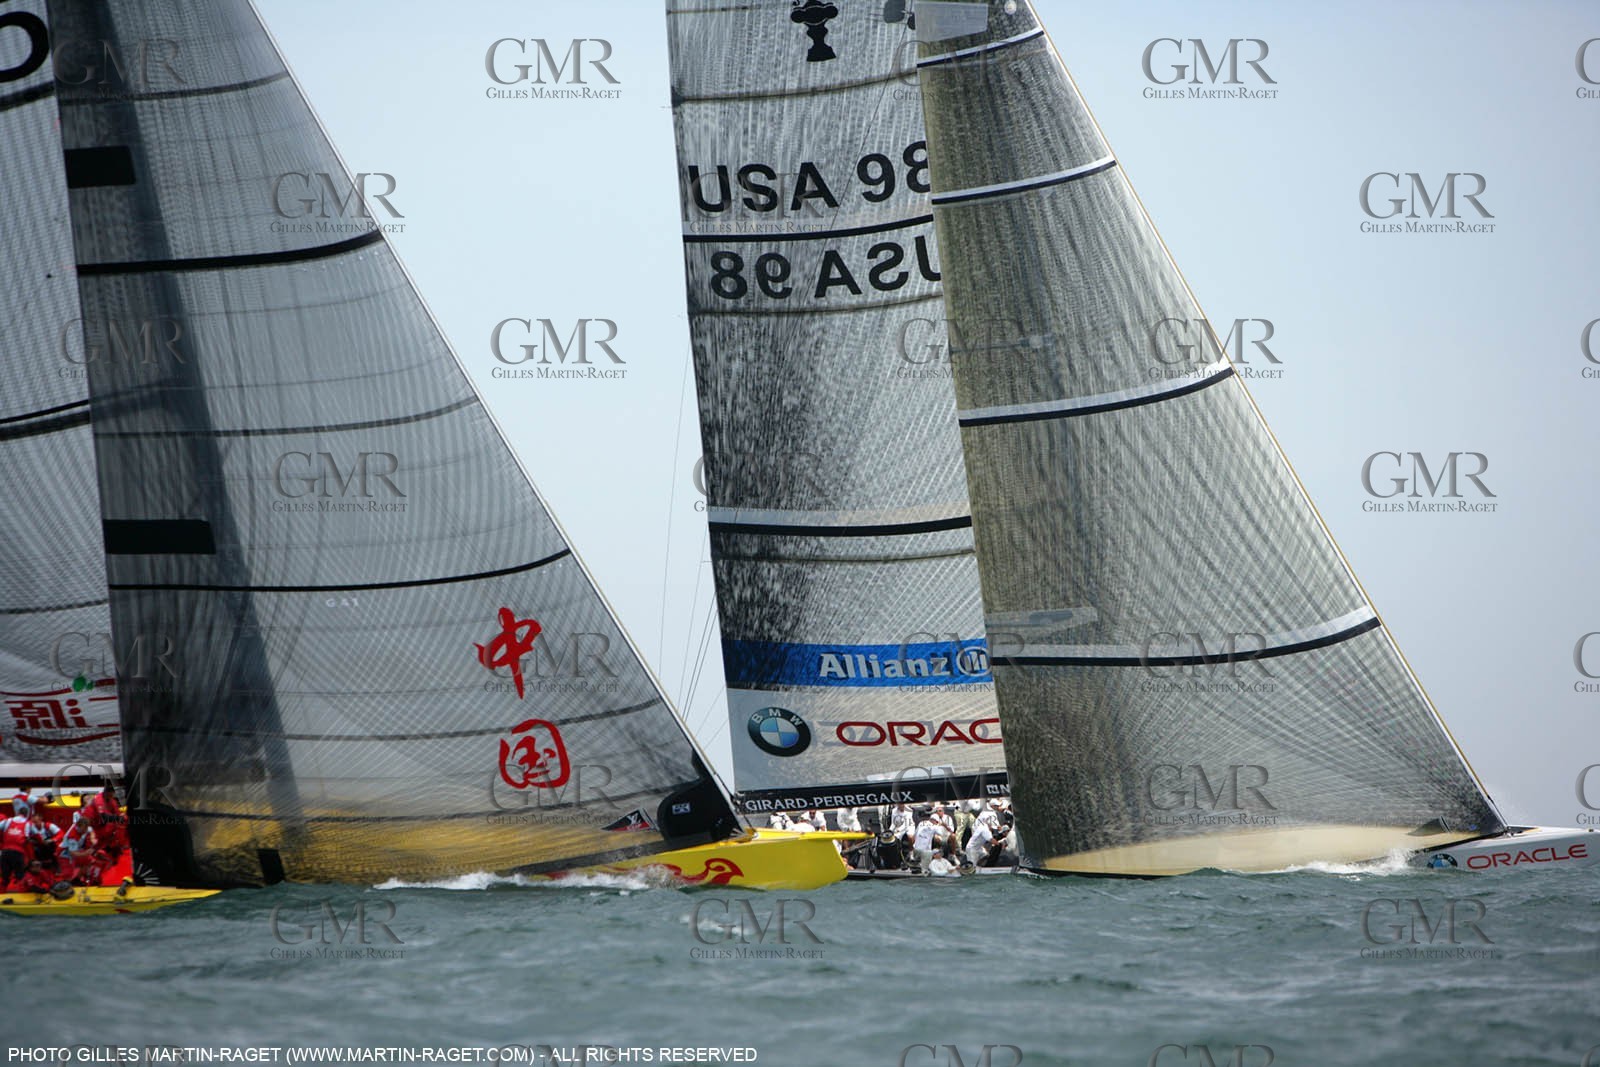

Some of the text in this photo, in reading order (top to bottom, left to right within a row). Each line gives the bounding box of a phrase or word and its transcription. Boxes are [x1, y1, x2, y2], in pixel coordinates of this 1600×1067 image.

[688, 140, 931, 213] USA 98
[819, 652, 951, 679] Allianz
[751, 707, 804, 727] BMW
[745, 791, 914, 812] GIRARD-PERREGAUX
[1467, 843, 1588, 870] ORACLE
